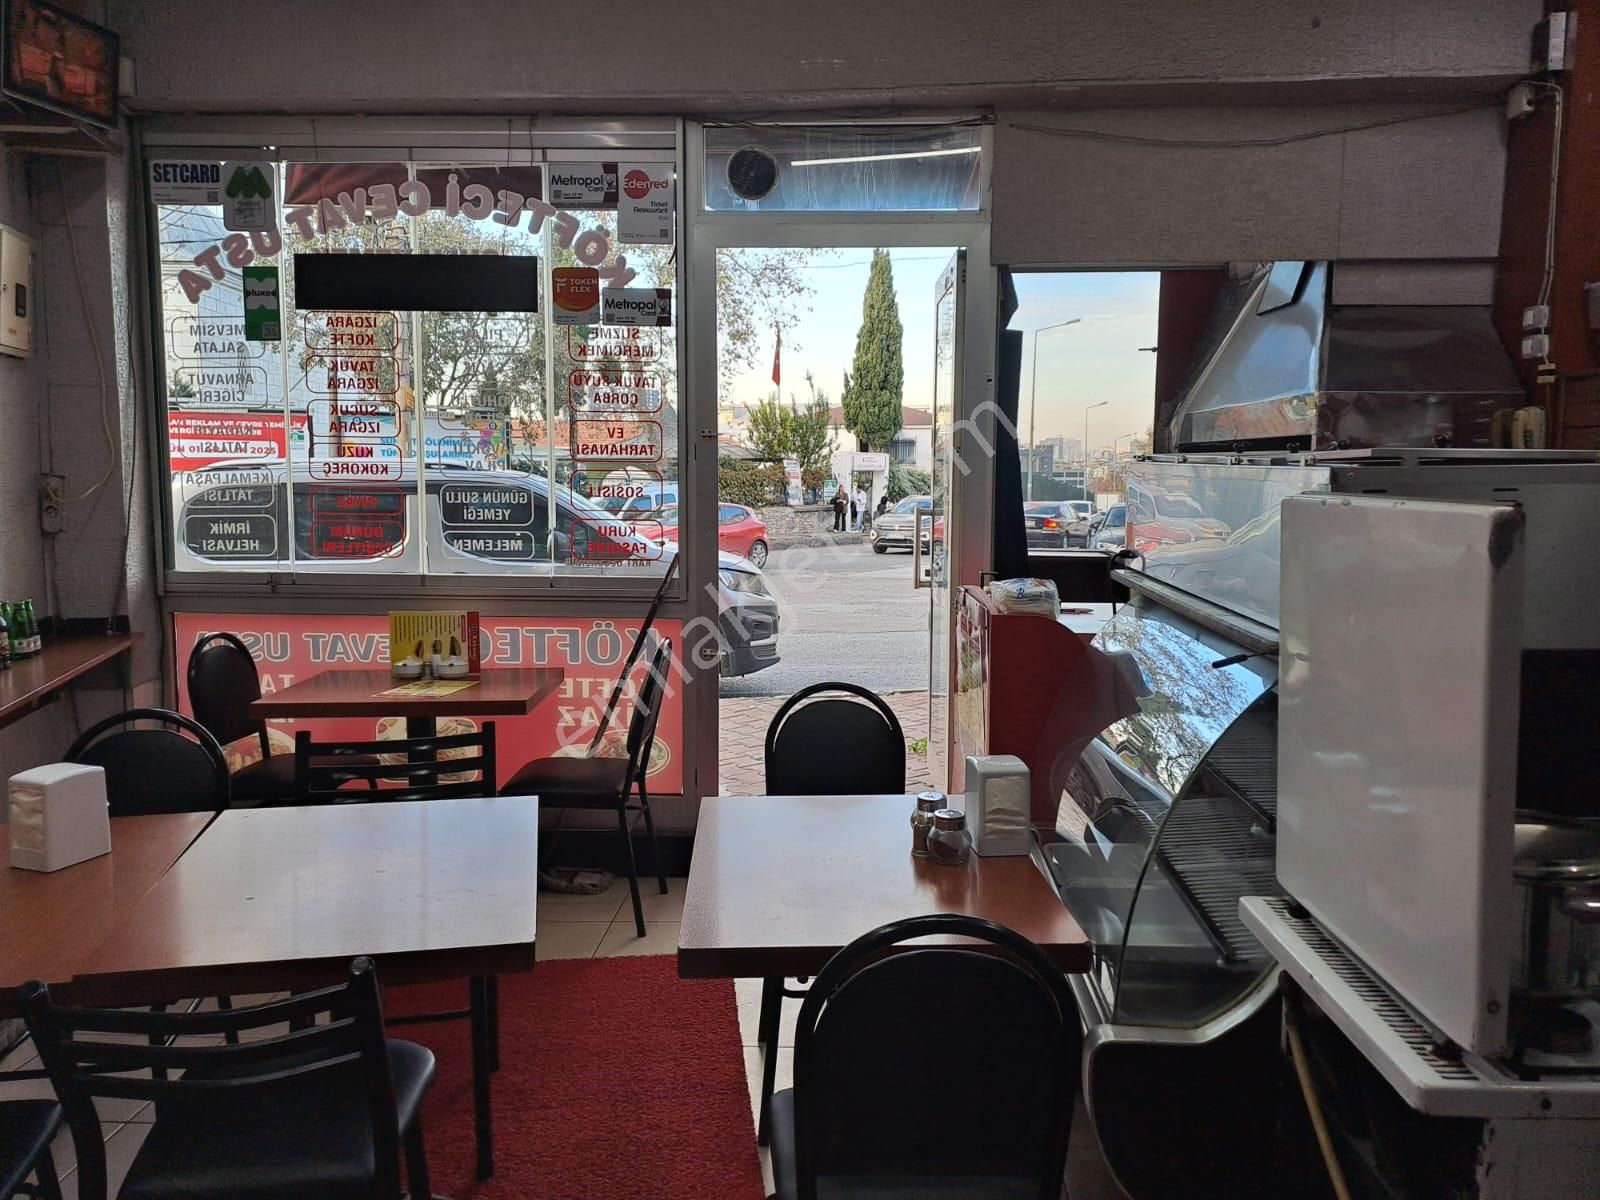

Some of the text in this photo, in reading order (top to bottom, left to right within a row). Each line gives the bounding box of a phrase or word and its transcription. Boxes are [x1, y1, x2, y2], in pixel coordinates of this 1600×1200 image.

[152, 162, 220, 184] SETCARD
[551, 174, 604, 189] Metropol
[623, 178, 669, 190] Edenred
[632, 206, 669, 214] Restaurant
[649, 200, 669, 208] Ticket
[569, 277, 598, 286] TOKEN
[604, 297, 657, 312] Metropol
[185, 418, 221, 427] REKLAM
[264, 420, 302, 430] TEMİLİK
[249, 445, 277, 455] 2025
